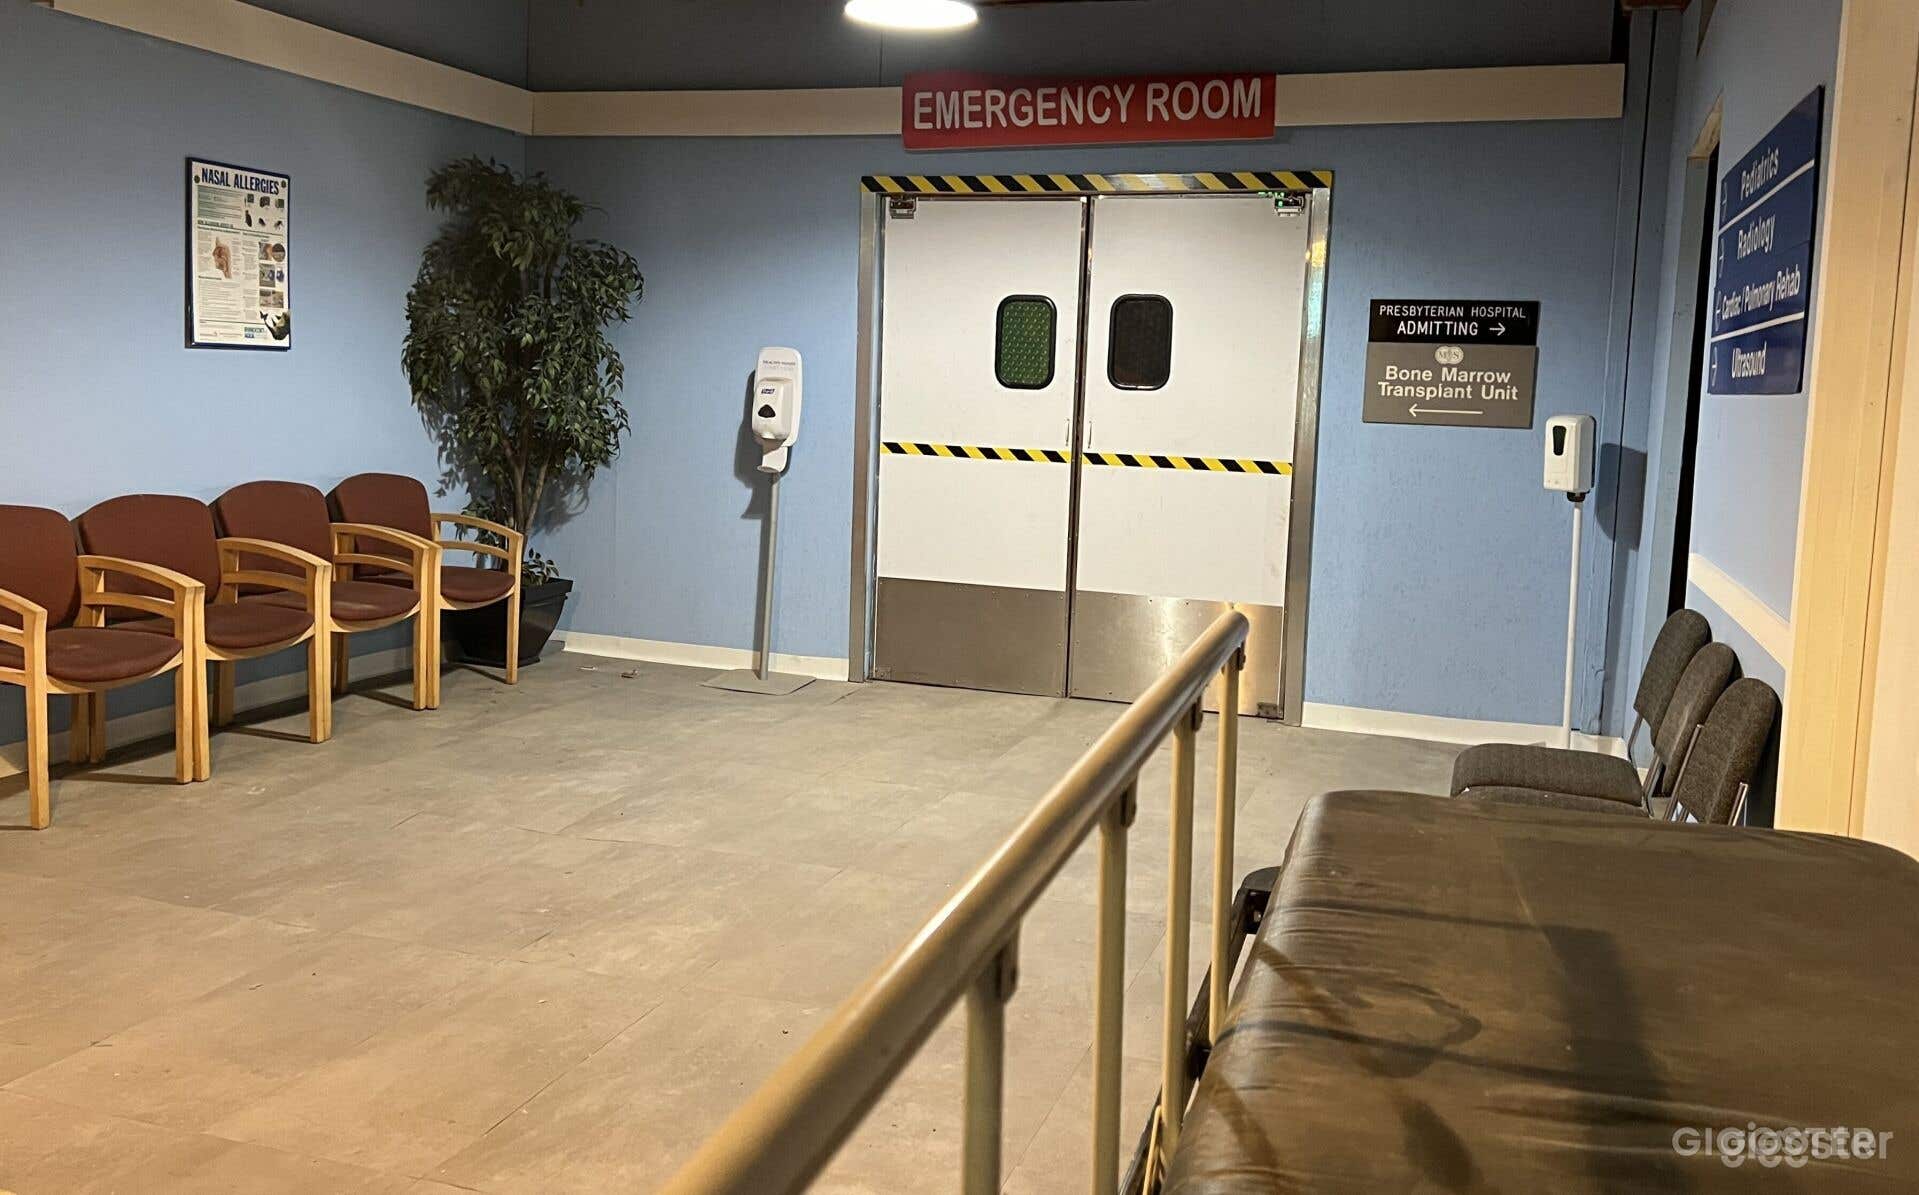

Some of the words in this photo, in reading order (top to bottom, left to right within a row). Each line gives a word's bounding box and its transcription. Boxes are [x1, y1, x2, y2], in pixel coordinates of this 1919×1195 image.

[913, 83, 1136, 130] EMERGENCY
[1146, 77, 1262, 122] ROOM
[201, 167, 231, 188] NASAL
[233, 173, 280, 196] ALLERGIES
[1740, 146, 1779, 201] Pediatrics
[1737, 214, 1776, 260] Radiology
[1721, 290, 1742, 321] Cardiac
[1743, 279, 1776, 313] Pulmonary
[1775, 263, 1801, 302] Rehab
[1379, 305, 1464, 317] PRESBYTERIAN
[1471, 306, 1526, 319] HOSPITAL
[1397, 321, 1479, 336] ADMITTING
[1385, 365, 1433, 382] Bone
[1441, 367, 1511, 383] Marrow
[1731, 340, 1768, 379] Ultrasound
[1378, 382, 1473, 400] Transplant
[1481, 385, 1519, 400] Unit
